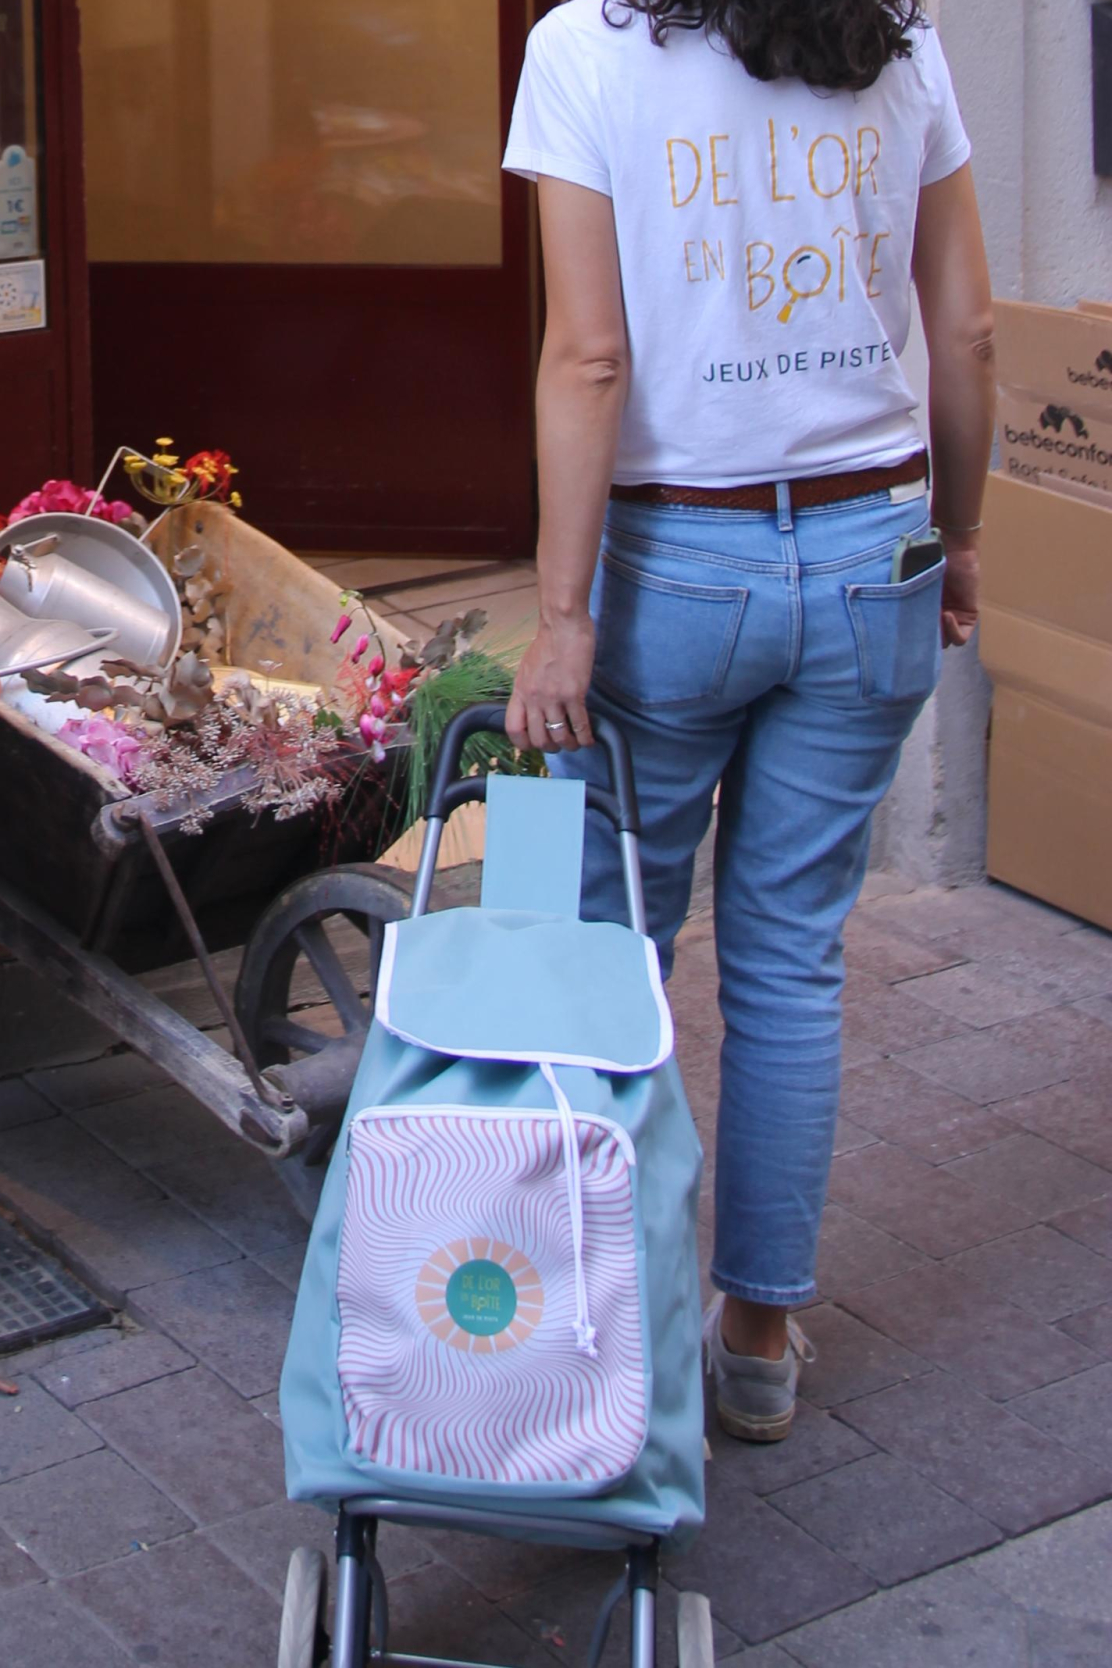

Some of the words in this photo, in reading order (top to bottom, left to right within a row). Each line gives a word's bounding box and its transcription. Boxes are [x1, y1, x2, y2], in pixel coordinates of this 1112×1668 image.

[666, 134, 738, 208] DE
[768, 118, 880, 202] L'OR
[684, 239, 725, 282] EN
[703, 358, 769, 383] JEUX
[777, 351, 808, 375] DE
[820, 340, 892, 370] PISTE
[1066, 366, 1112, 392] bebe
